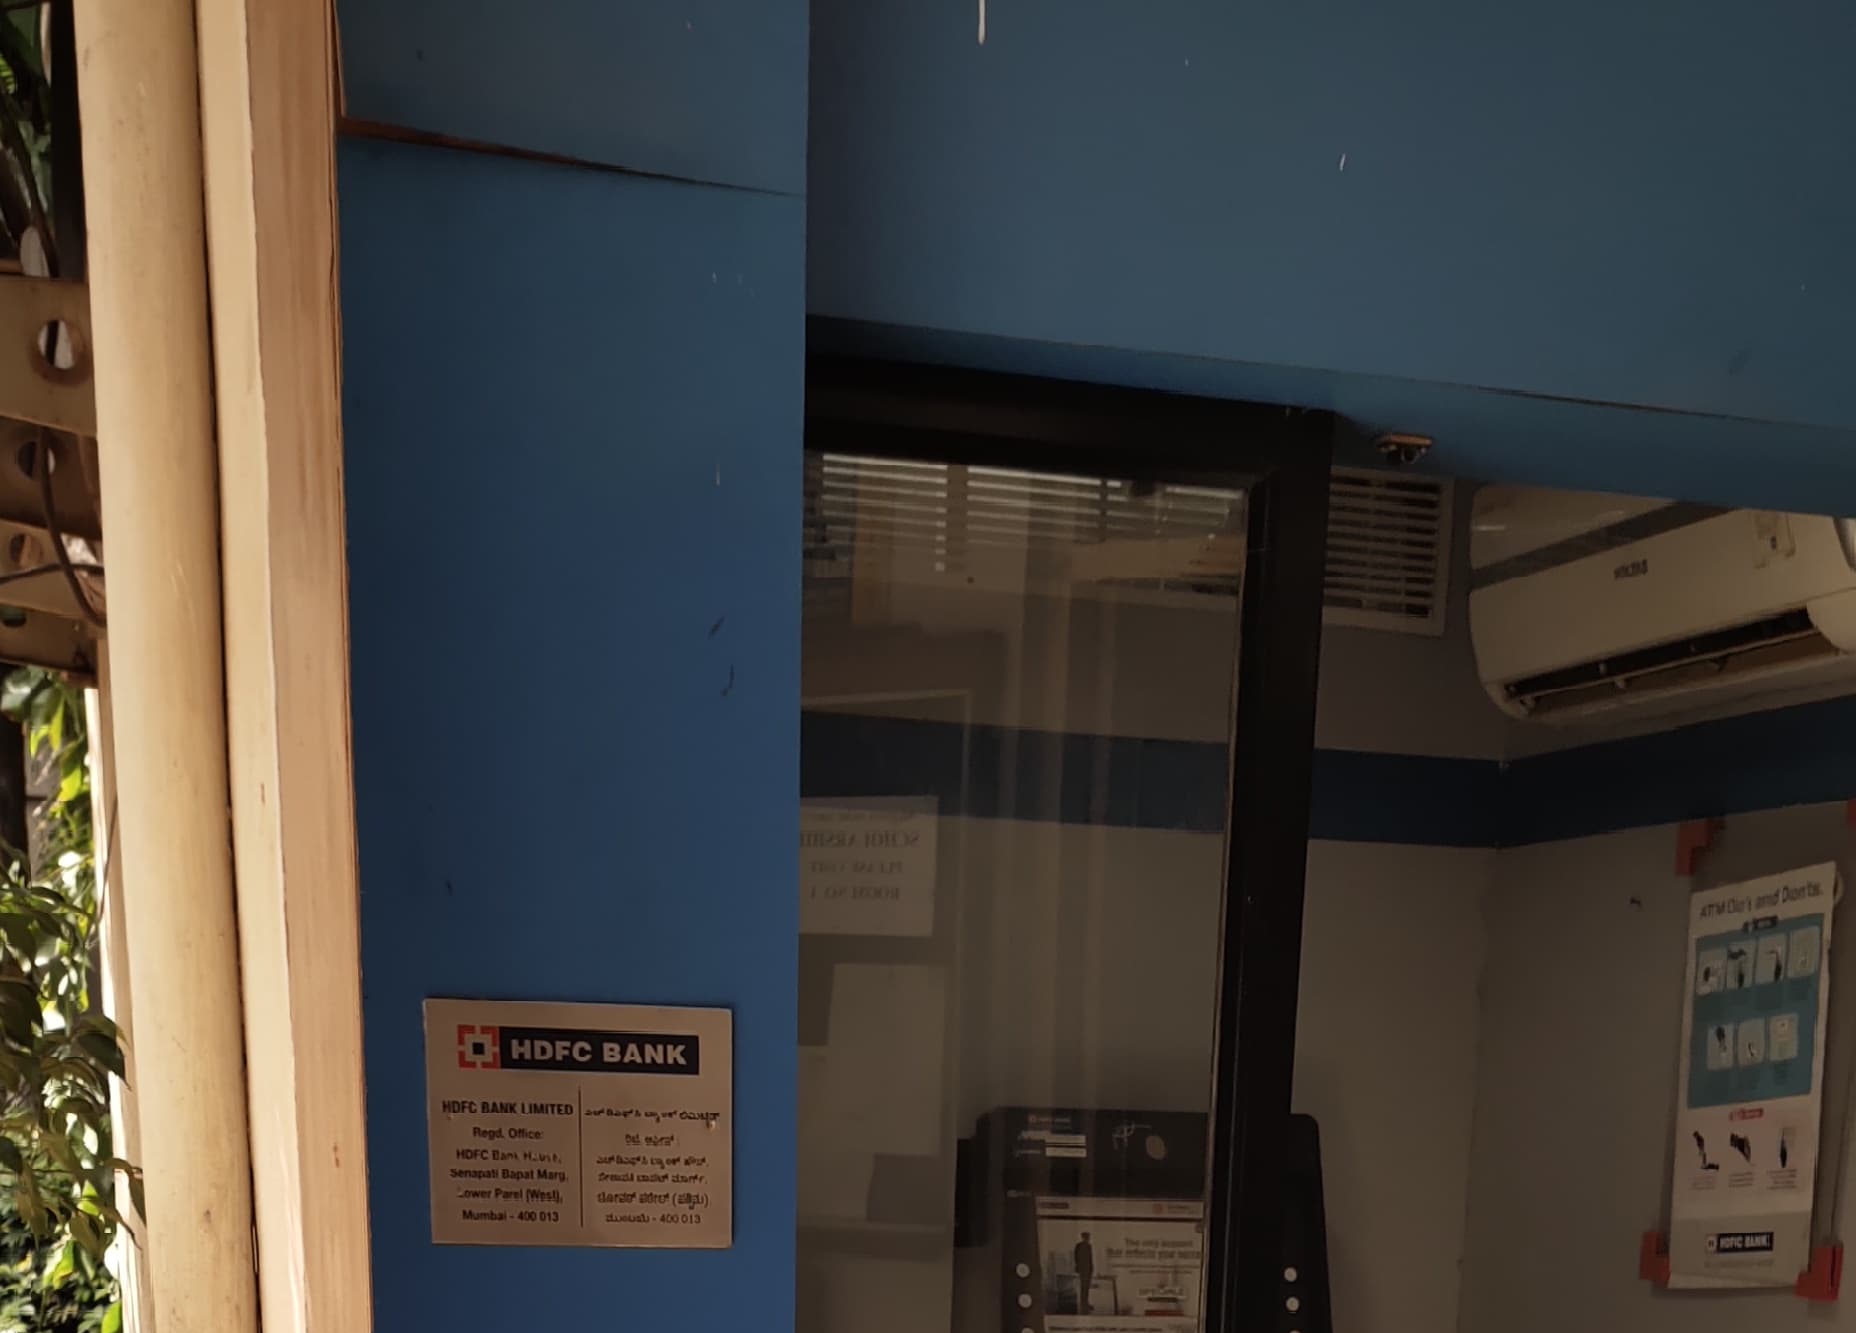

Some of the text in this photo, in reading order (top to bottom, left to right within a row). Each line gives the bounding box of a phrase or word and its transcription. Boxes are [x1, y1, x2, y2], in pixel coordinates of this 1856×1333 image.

[510, 1038, 688, 1066] HDFC BANK
[441, 1100, 574, 1116] HDFC BANK LIMITED
[472, 1126, 544, 1141] Regd. Office:
[456, 1149, 489, 1161] HDFC
[450, 1168, 499, 1180] Senapati
[502, 1169, 534, 1181] Bapat
[494, 1188, 523, 1200] Parel
[462, 1209, 507, 1221] Mumbai
[518, 1210, 537, 1222] 400
[540, 1211, 560, 1222] 013
[659, 1213, 679, 1224] 400
[681, 1214, 702, 1224] 013
